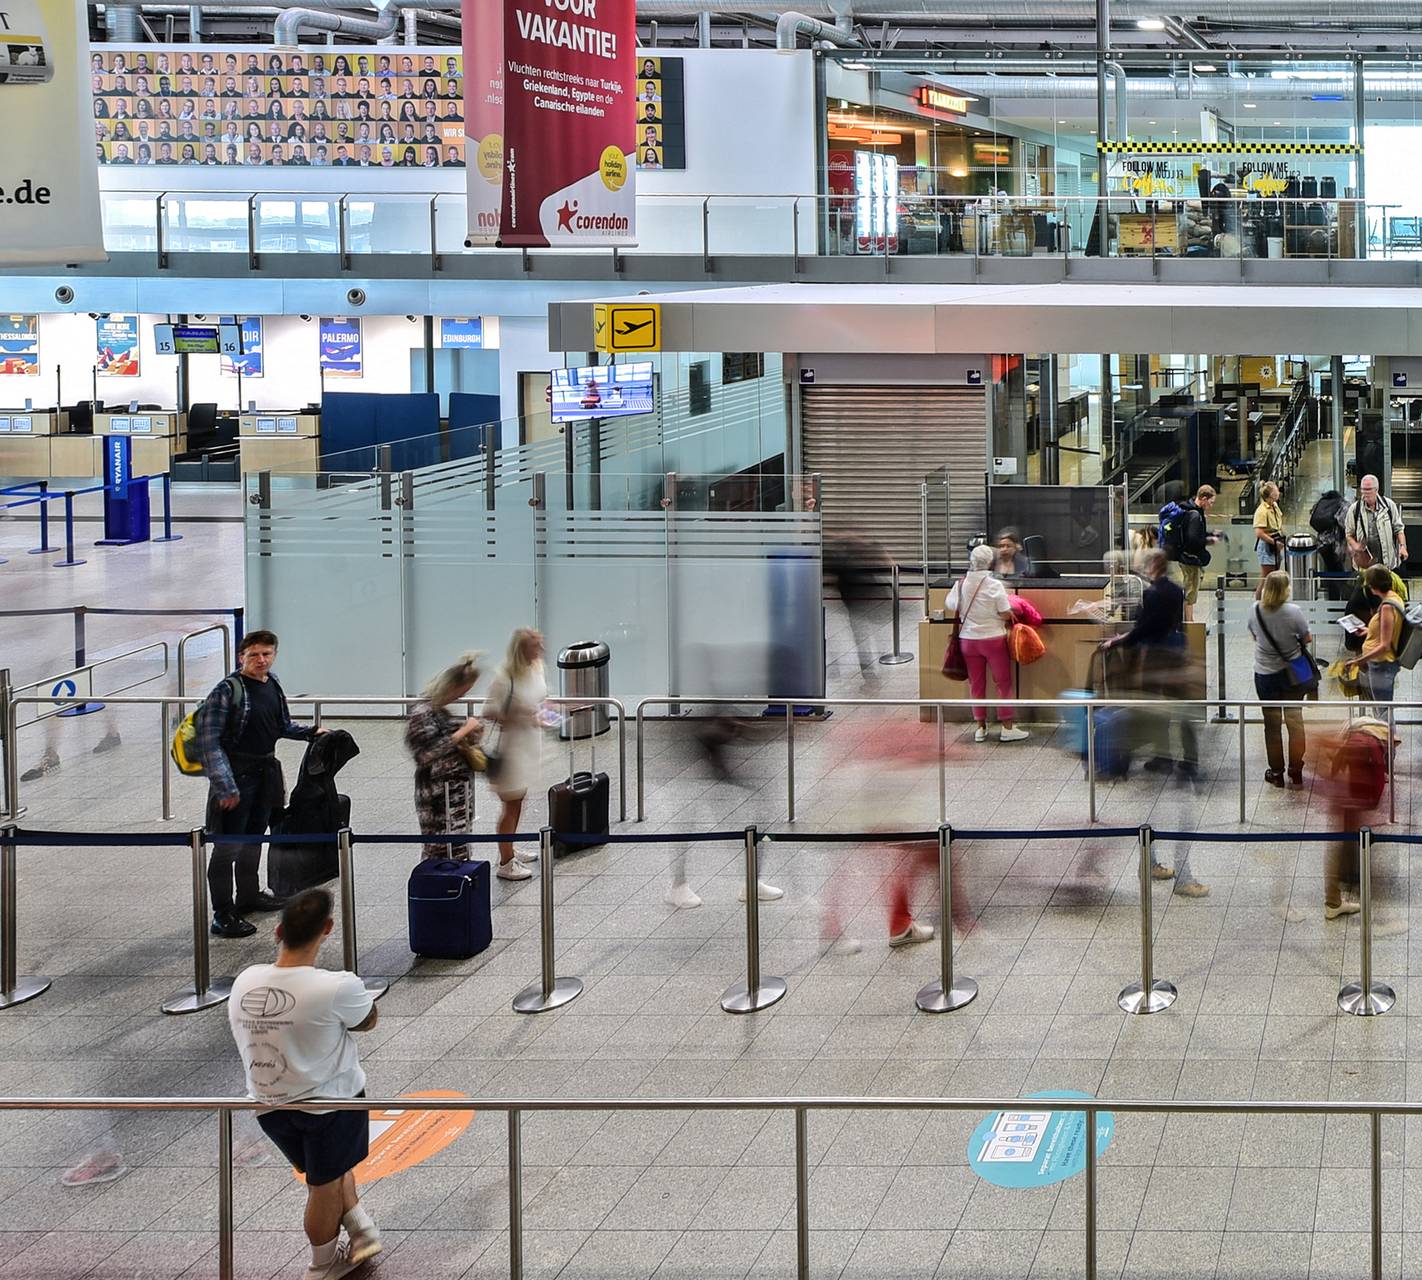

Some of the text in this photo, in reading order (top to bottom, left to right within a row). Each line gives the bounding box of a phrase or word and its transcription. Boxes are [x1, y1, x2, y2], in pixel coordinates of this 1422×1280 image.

[516, 9, 617, 60] VAKANTIE!
[508, 60, 541, 78] Vluchten
[543, 68, 584, 87] rechtstreeks
[585, 76, 599, 88] naar
[523, 79, 614, 105] Griekenland, Egypte en de
[534, 95, 605, 117] Canarische eilanden
[444, 128, 457, 138] WIR
[1122, 161, 1168, 172] FOLLOW ME
[1242, 161, 1288, 173] FOLLOW ME
[576, 212, 629, 231] corendon
[243, 331, 259, 342] DIR
[322, 333, 359, 344] PALERMO
[443, 334, 481, 344] EDINBURGH
[160, 341, 171, 351] 15
[225, 342, 236, 352] 16
